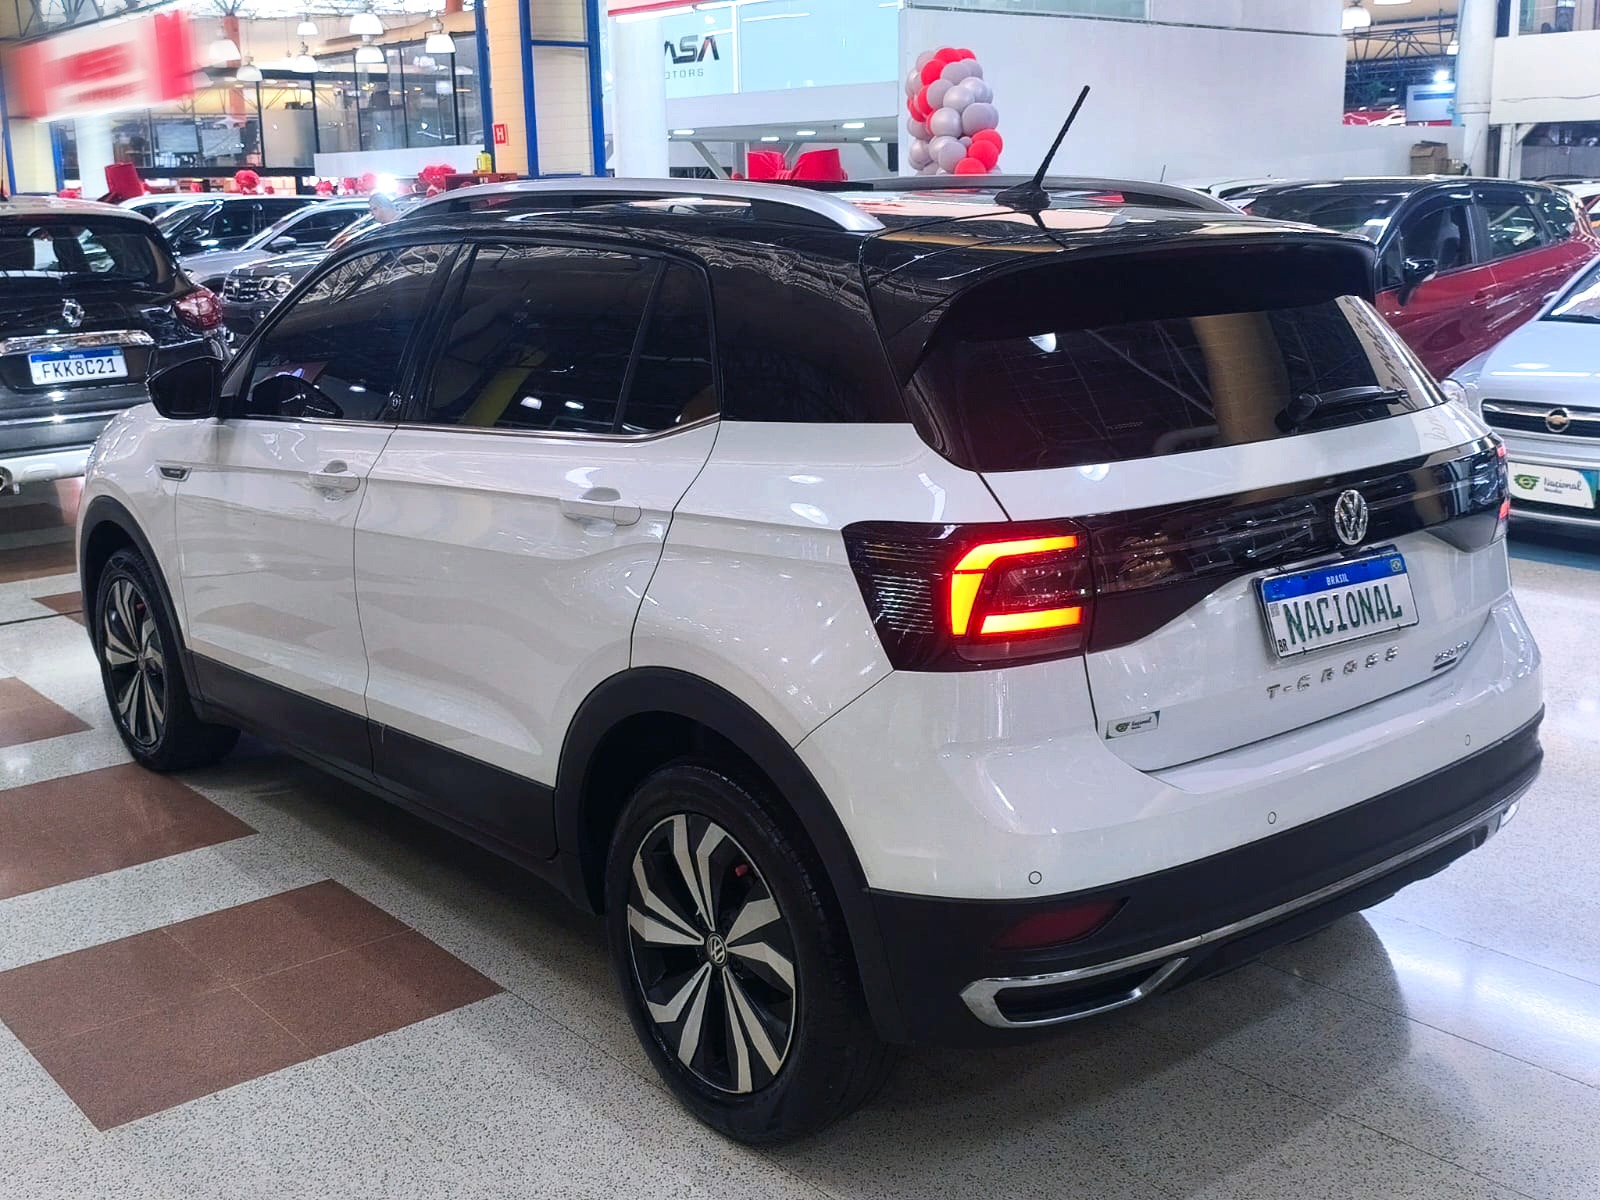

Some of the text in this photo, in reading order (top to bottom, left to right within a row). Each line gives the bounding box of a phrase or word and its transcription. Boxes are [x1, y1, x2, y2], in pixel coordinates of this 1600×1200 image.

[664, 34, 720, 65] ASA
[664, 68, 704, 80] OTORS
[42, 358, 116, 378] FKK8C21
[1543, 477, 1582, 491] Nacional
[1325, 573, 1349, 586] BRASIL
[1282, 583, 1403, 645] NACIONAL
[1277, 638, 1289, 653] BR
